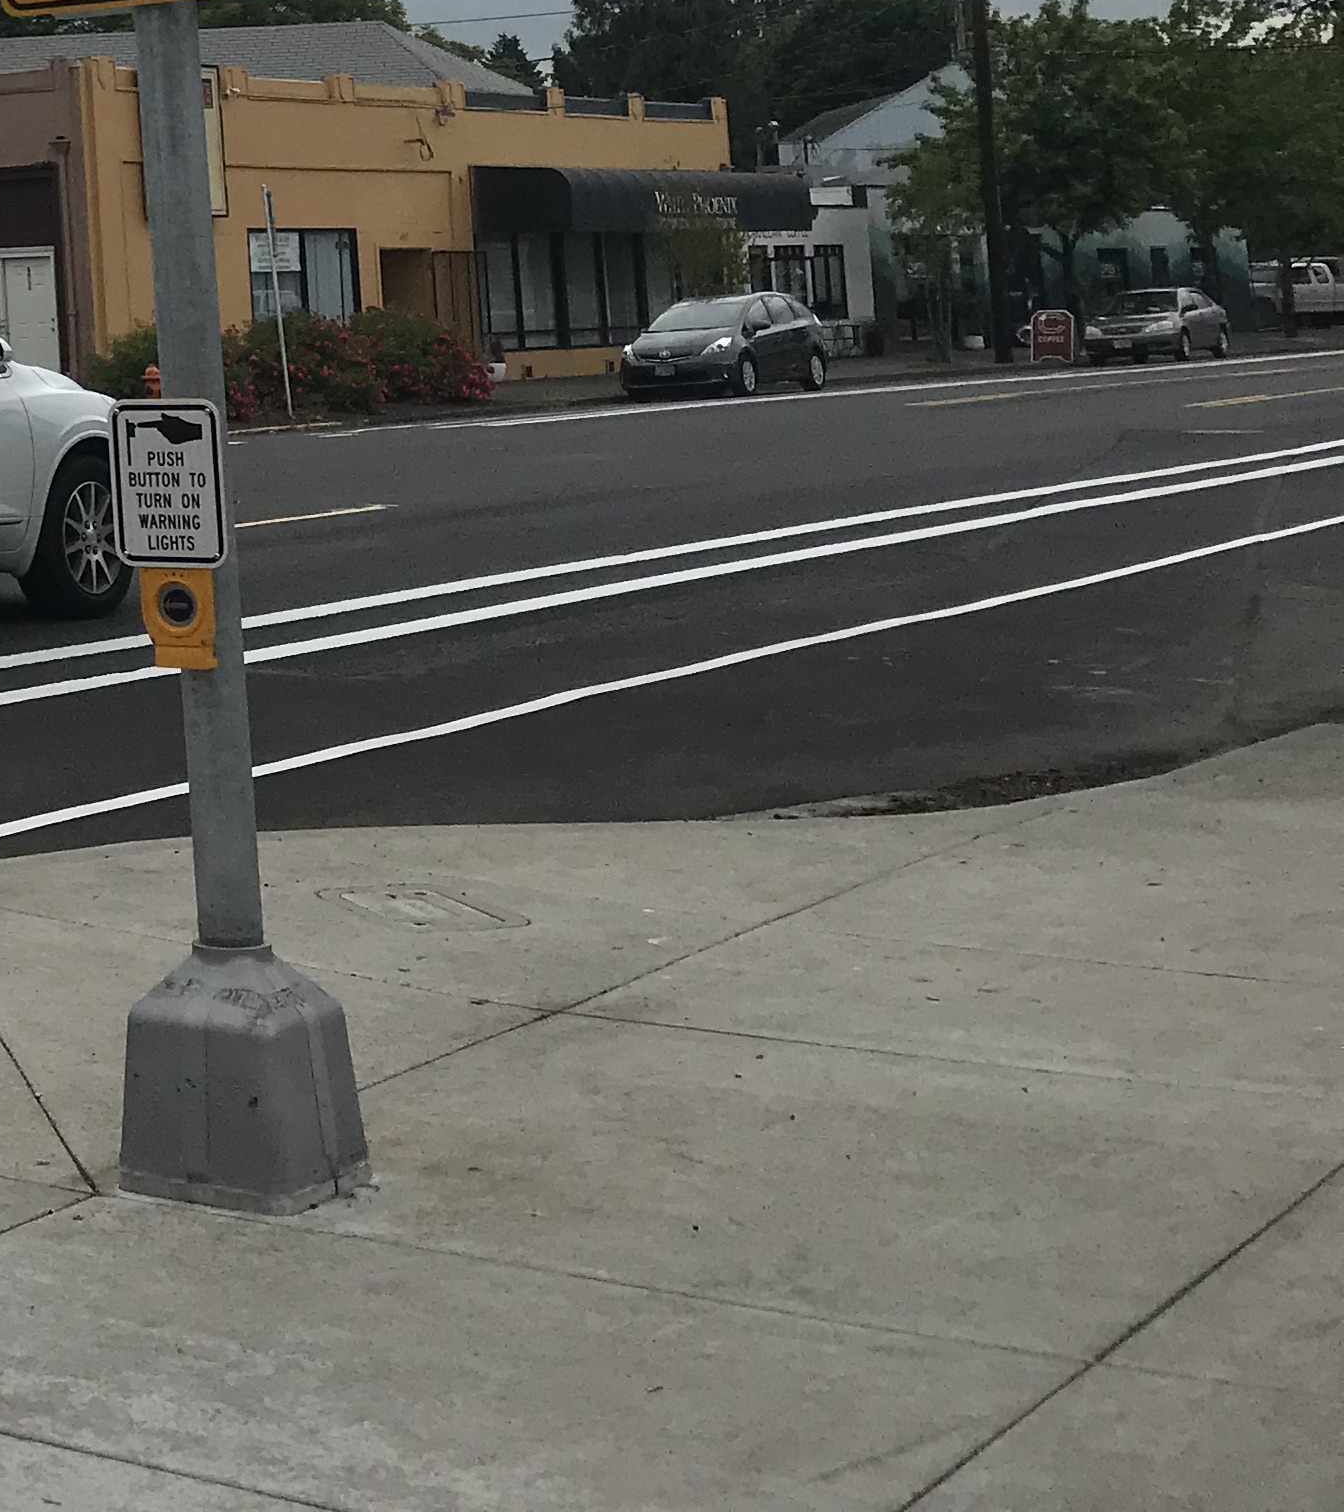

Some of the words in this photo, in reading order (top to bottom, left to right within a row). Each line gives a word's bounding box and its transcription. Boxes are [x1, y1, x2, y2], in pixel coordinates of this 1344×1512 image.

[147, 451, 185, 467] PUSH
[128, 472, 180, 488] BUTTON
[189, 472, 207, 488] TO
[136, 492, 172, 508] TURN
[181, 493, 201, 509] ON
[138, 514, 201, 530] WARNING
[147, 534, 196, 551] LIGHTS
